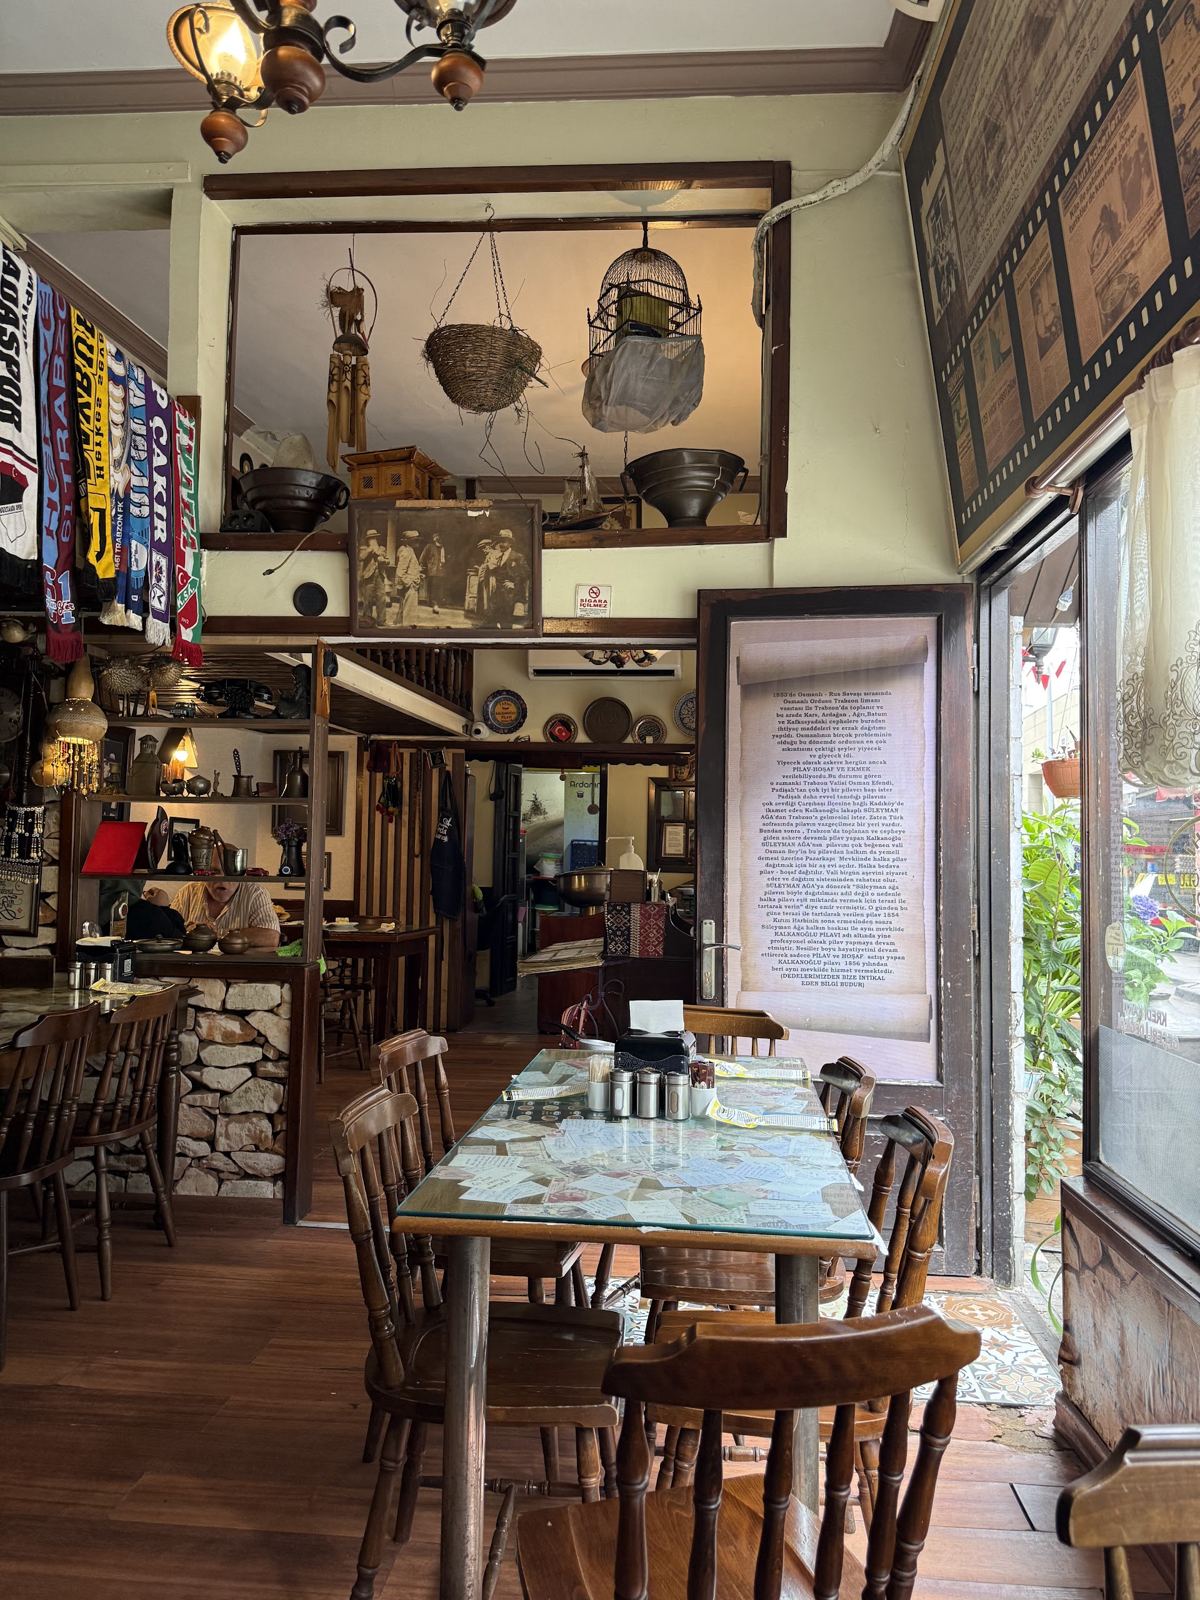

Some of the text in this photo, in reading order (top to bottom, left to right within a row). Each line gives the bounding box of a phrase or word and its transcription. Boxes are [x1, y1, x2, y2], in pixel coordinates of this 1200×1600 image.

[150, 416, 168, 543] ÇAKIR
[117, 501, 124, 513] FK
[115, 514, 123, 554] TRABZON
